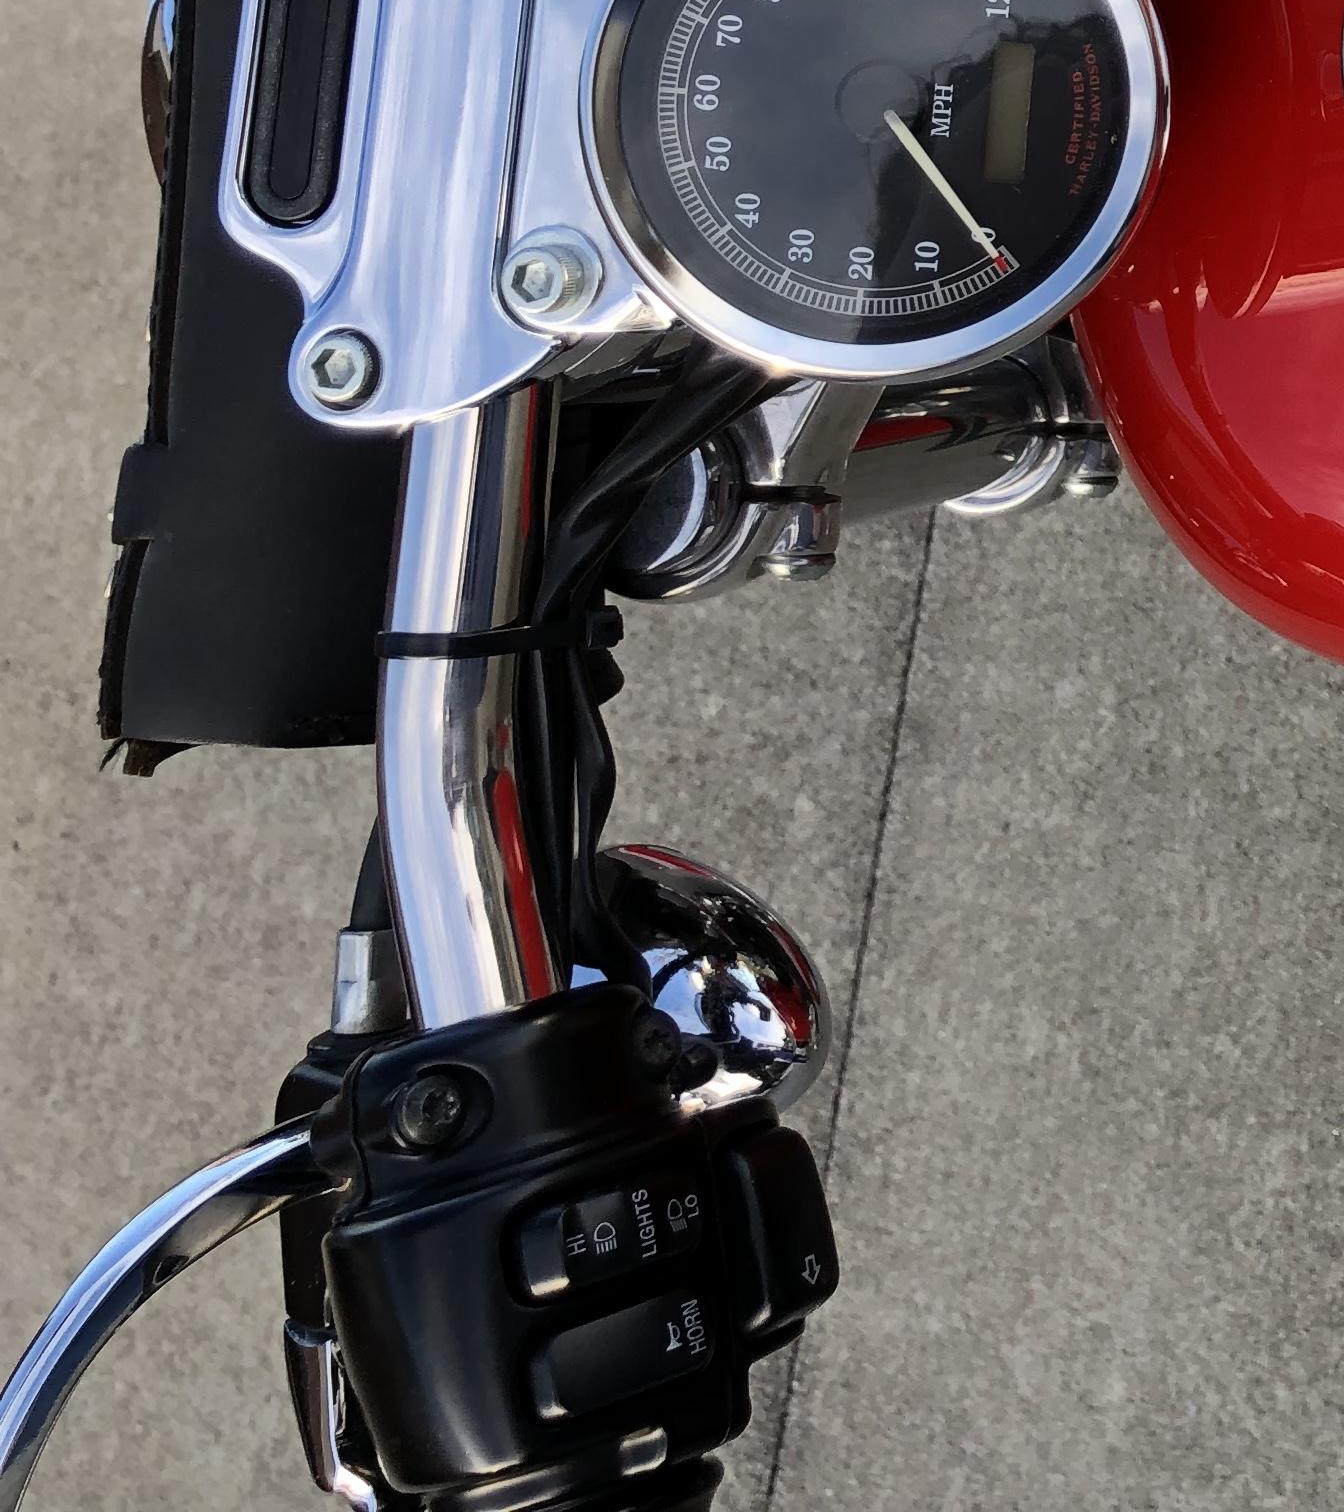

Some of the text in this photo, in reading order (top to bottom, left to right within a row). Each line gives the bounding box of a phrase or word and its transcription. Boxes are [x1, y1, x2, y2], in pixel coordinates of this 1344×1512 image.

[715, 13, 744, 48] 70
[693, 73, 722, 113] 60
[930, 82, 955, 138] MPH
[1065, 70, 1085, 166] CERTIFIED
[703, 135, 733, 173] 50
[733, 191, 762, 229] 40
[787, 227, 816, 265] 30
[847, 245, 876, 282] 20
[913, 240, 941, 273] 10
[631, 1188, 657, 1259] LIGHTS
[684, 1194, 700, 1218] LO
[566, 1233, 587, 1257] HI
[680, 1298, 707, 1355] HORN
